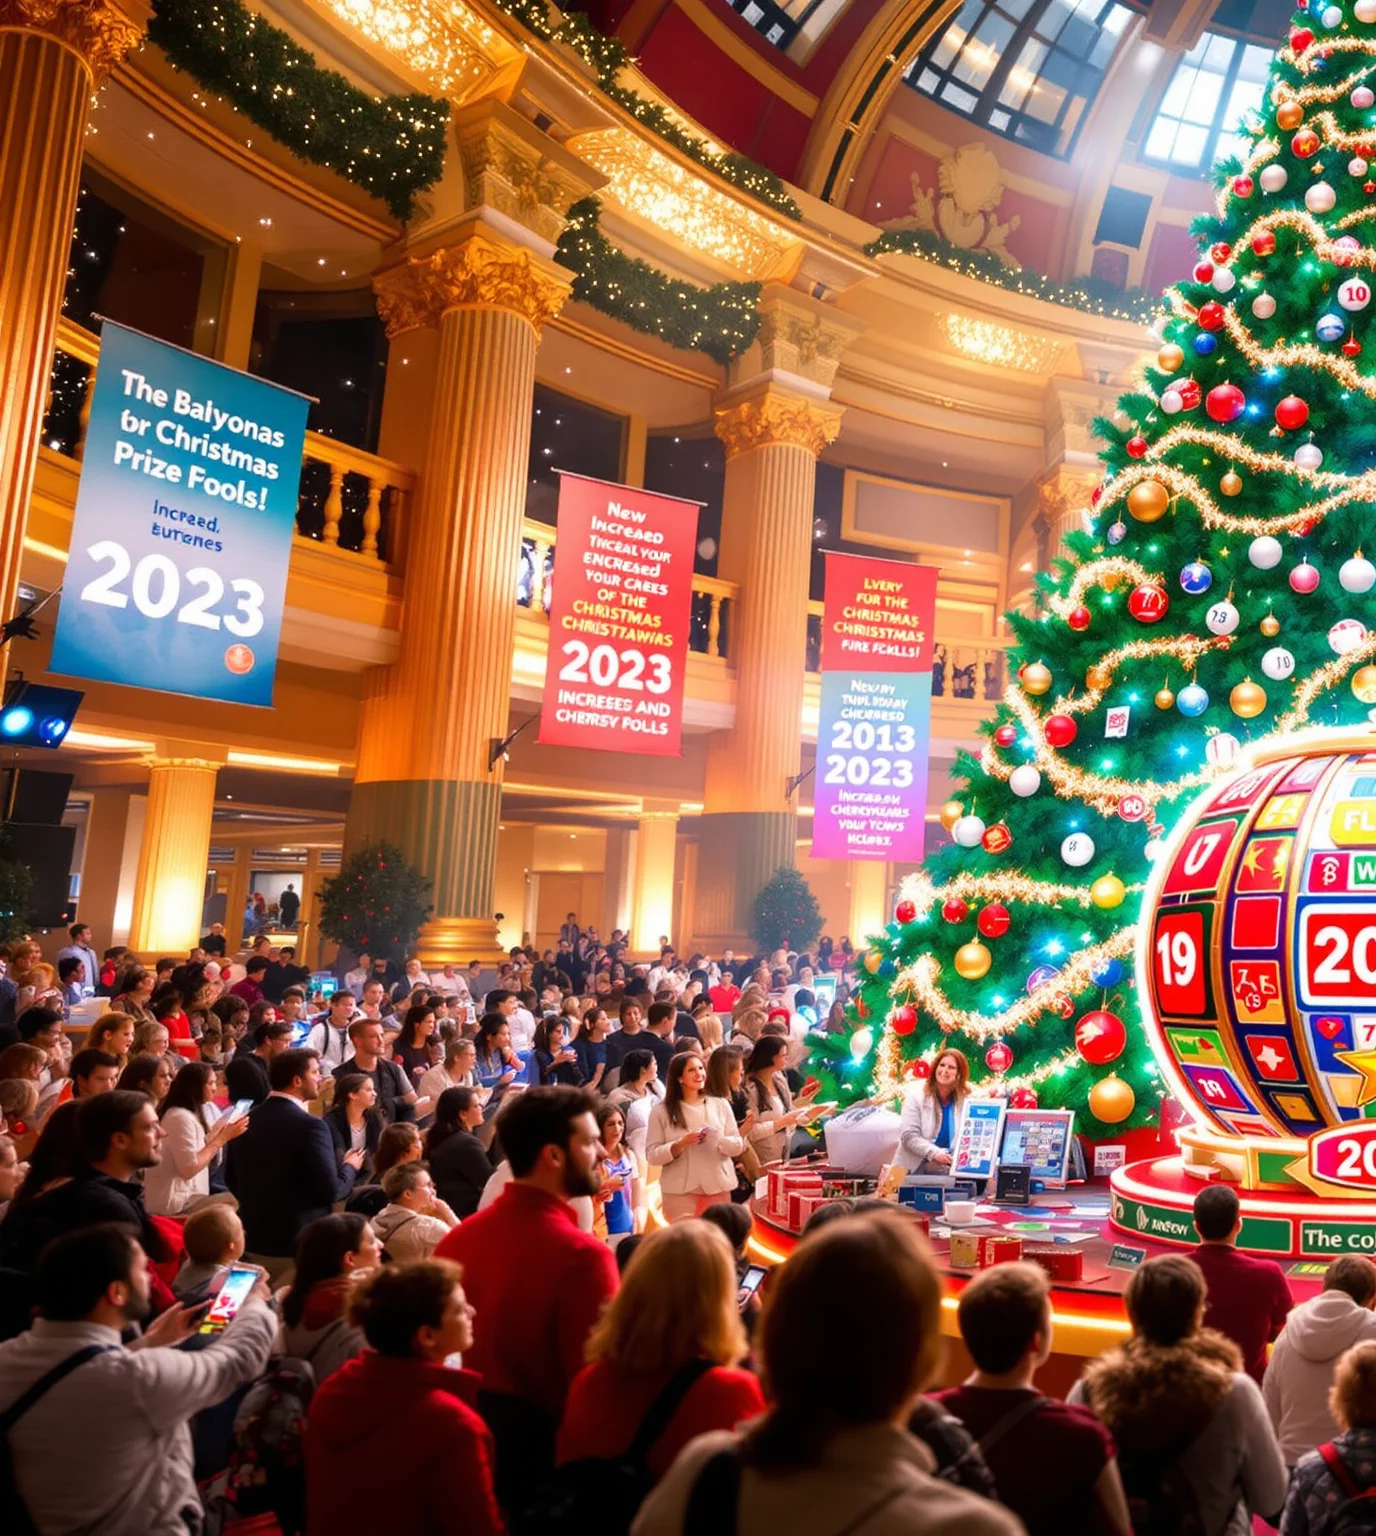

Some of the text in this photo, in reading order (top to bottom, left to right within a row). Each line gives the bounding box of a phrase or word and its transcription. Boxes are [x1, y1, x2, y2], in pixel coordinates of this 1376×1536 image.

[1346, 287, 1367, 302] 10
[122, 369, 168, 408] The
[156, 420, 279, 480] Christmas
[114, 440, 268, 511] Prize Fools!
[80, 540, 264, 637] 2023
[586, 569, 621, 586] YOUR
[597, 588, 648, 608] OF THE
[572, 600, 662, 628] CHRISTMAS
[842, 606, 920, 628] CHRISTMAS
[560, 640, 672, 694] 2023
[635, 700, 671, 717] AND
[832, 720, 916, 753] 2013
[824, 754, 914, 788] 2023
[1157, 931, 1196, 986] 19
[1362, 1024, 1376, 1042] 7
[1304, 1229, 1343, 1248] The
